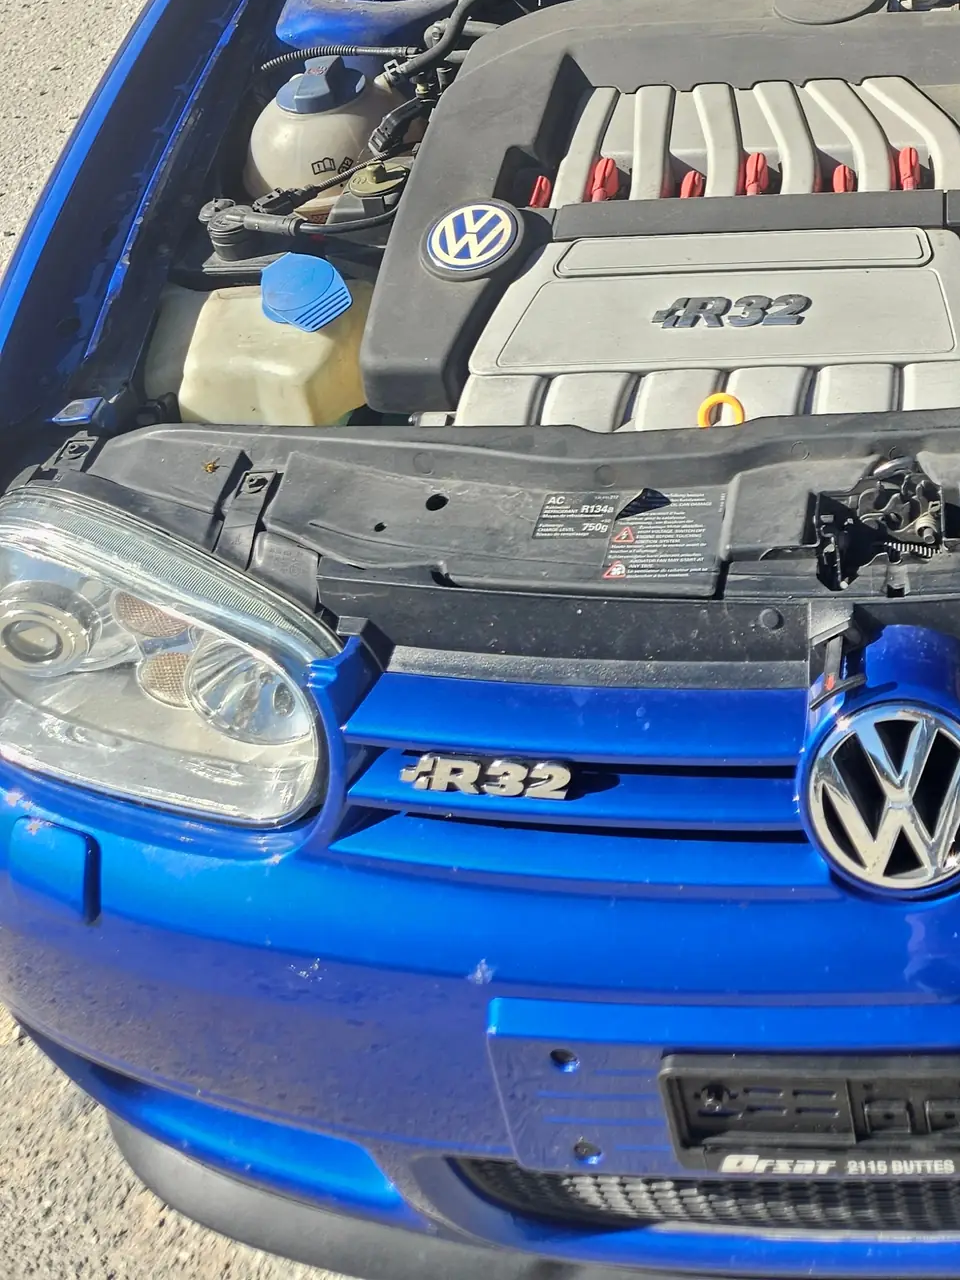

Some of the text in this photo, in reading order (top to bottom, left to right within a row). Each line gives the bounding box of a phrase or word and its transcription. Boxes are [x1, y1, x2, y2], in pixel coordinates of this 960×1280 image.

[547, 496, 566, 505] AC
[580, 505, 614, 513] R134a
[581, 523, 609, 533] 750g
[430, 754, 572, 800] R32
[847, 1160, 888, 1175] 2115
[891, 1159, 955, 1175] BUTTES
